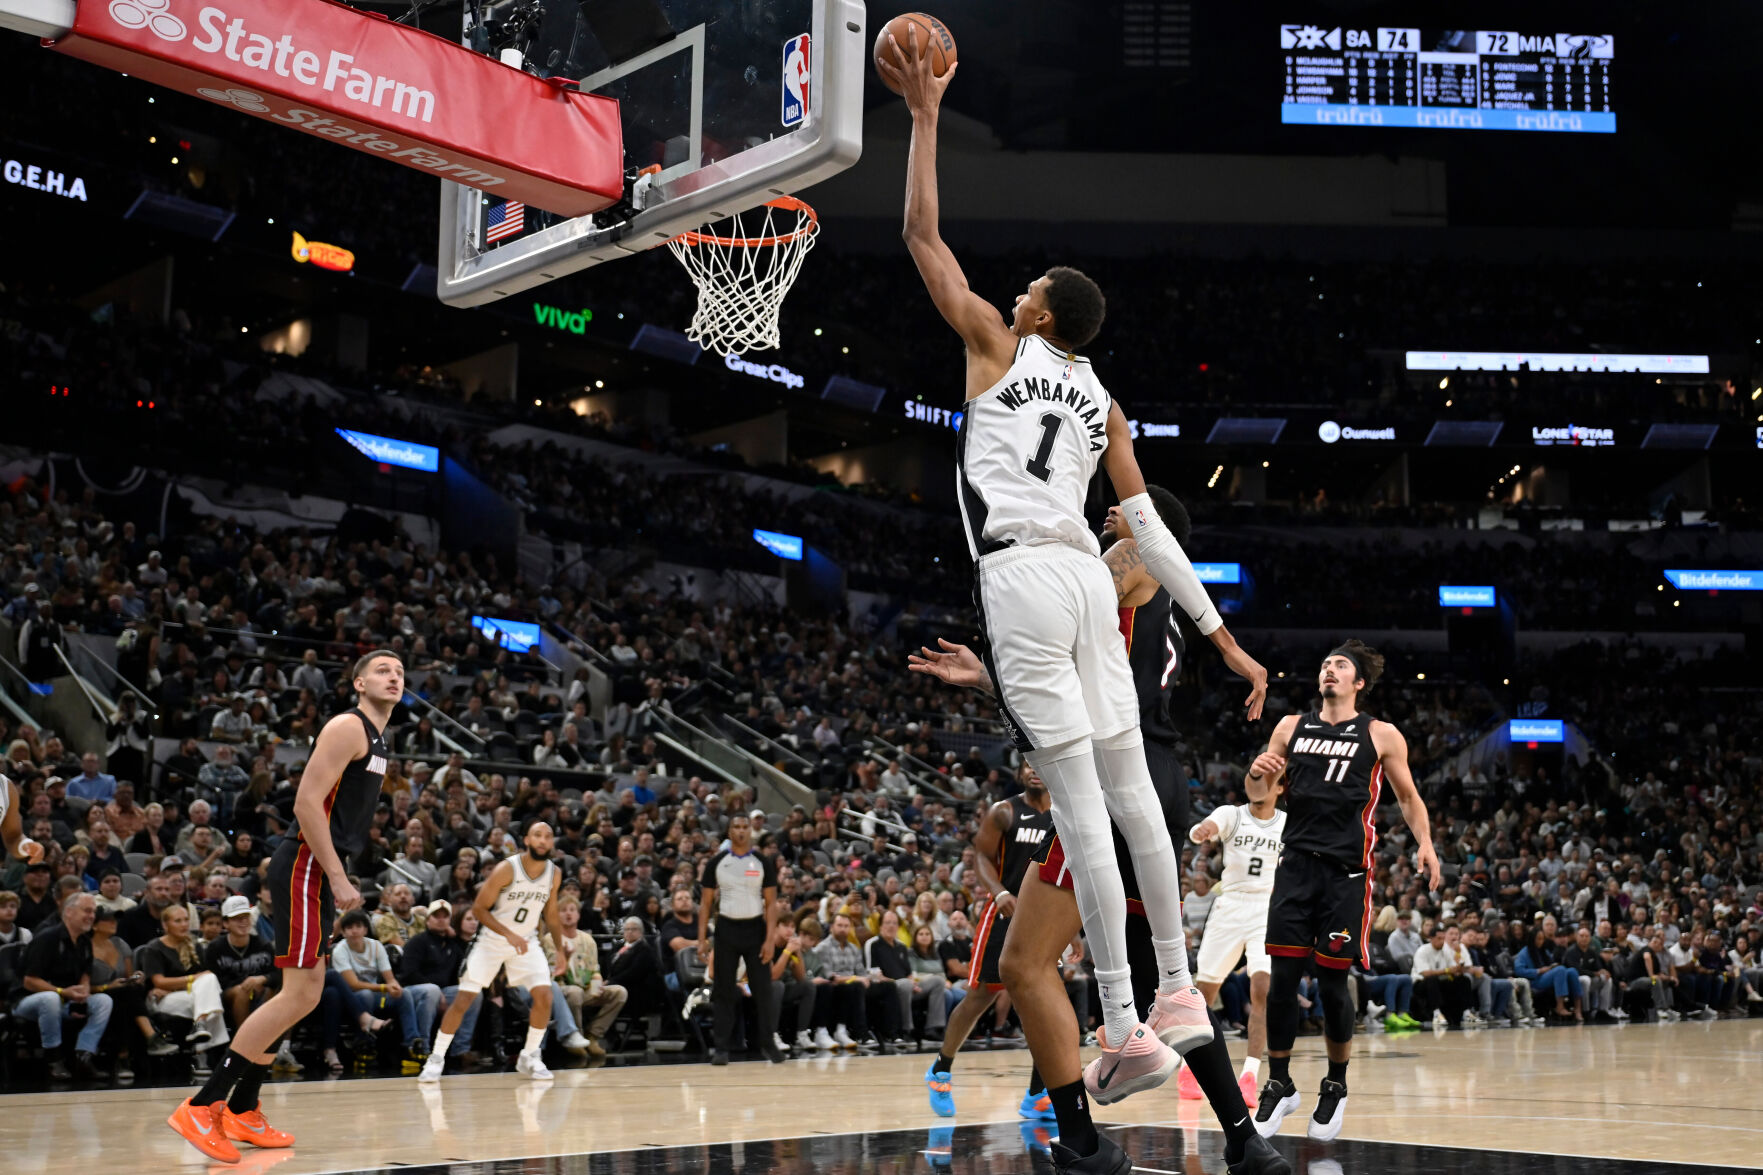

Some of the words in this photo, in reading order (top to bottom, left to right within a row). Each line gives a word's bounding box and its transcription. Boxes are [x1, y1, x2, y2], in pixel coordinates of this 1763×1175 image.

[1346, 30, 1372, 48] SA
[1386, 31, 1409, 49] 74
[1487, 34, 1509, 53] 72
[1520, 35, 1556, 53] MIA
[785, 104, 799, 121] NBA
[4, 160, 88, 202] G.E.H.A
[995, 377, 1106, 452] WEMBANYAMA
[1532, 427, 1570, 440] LONE
[1025, 411, 1065, 485] 1
[1292, 737, 1360, 758] MIAMI
[1324, 758, 1351, 783] 11
[1247, 856, 1263, 877] 2
[507, 890, 550, 904] SPURS
[514, 907, 528, 923] 0
